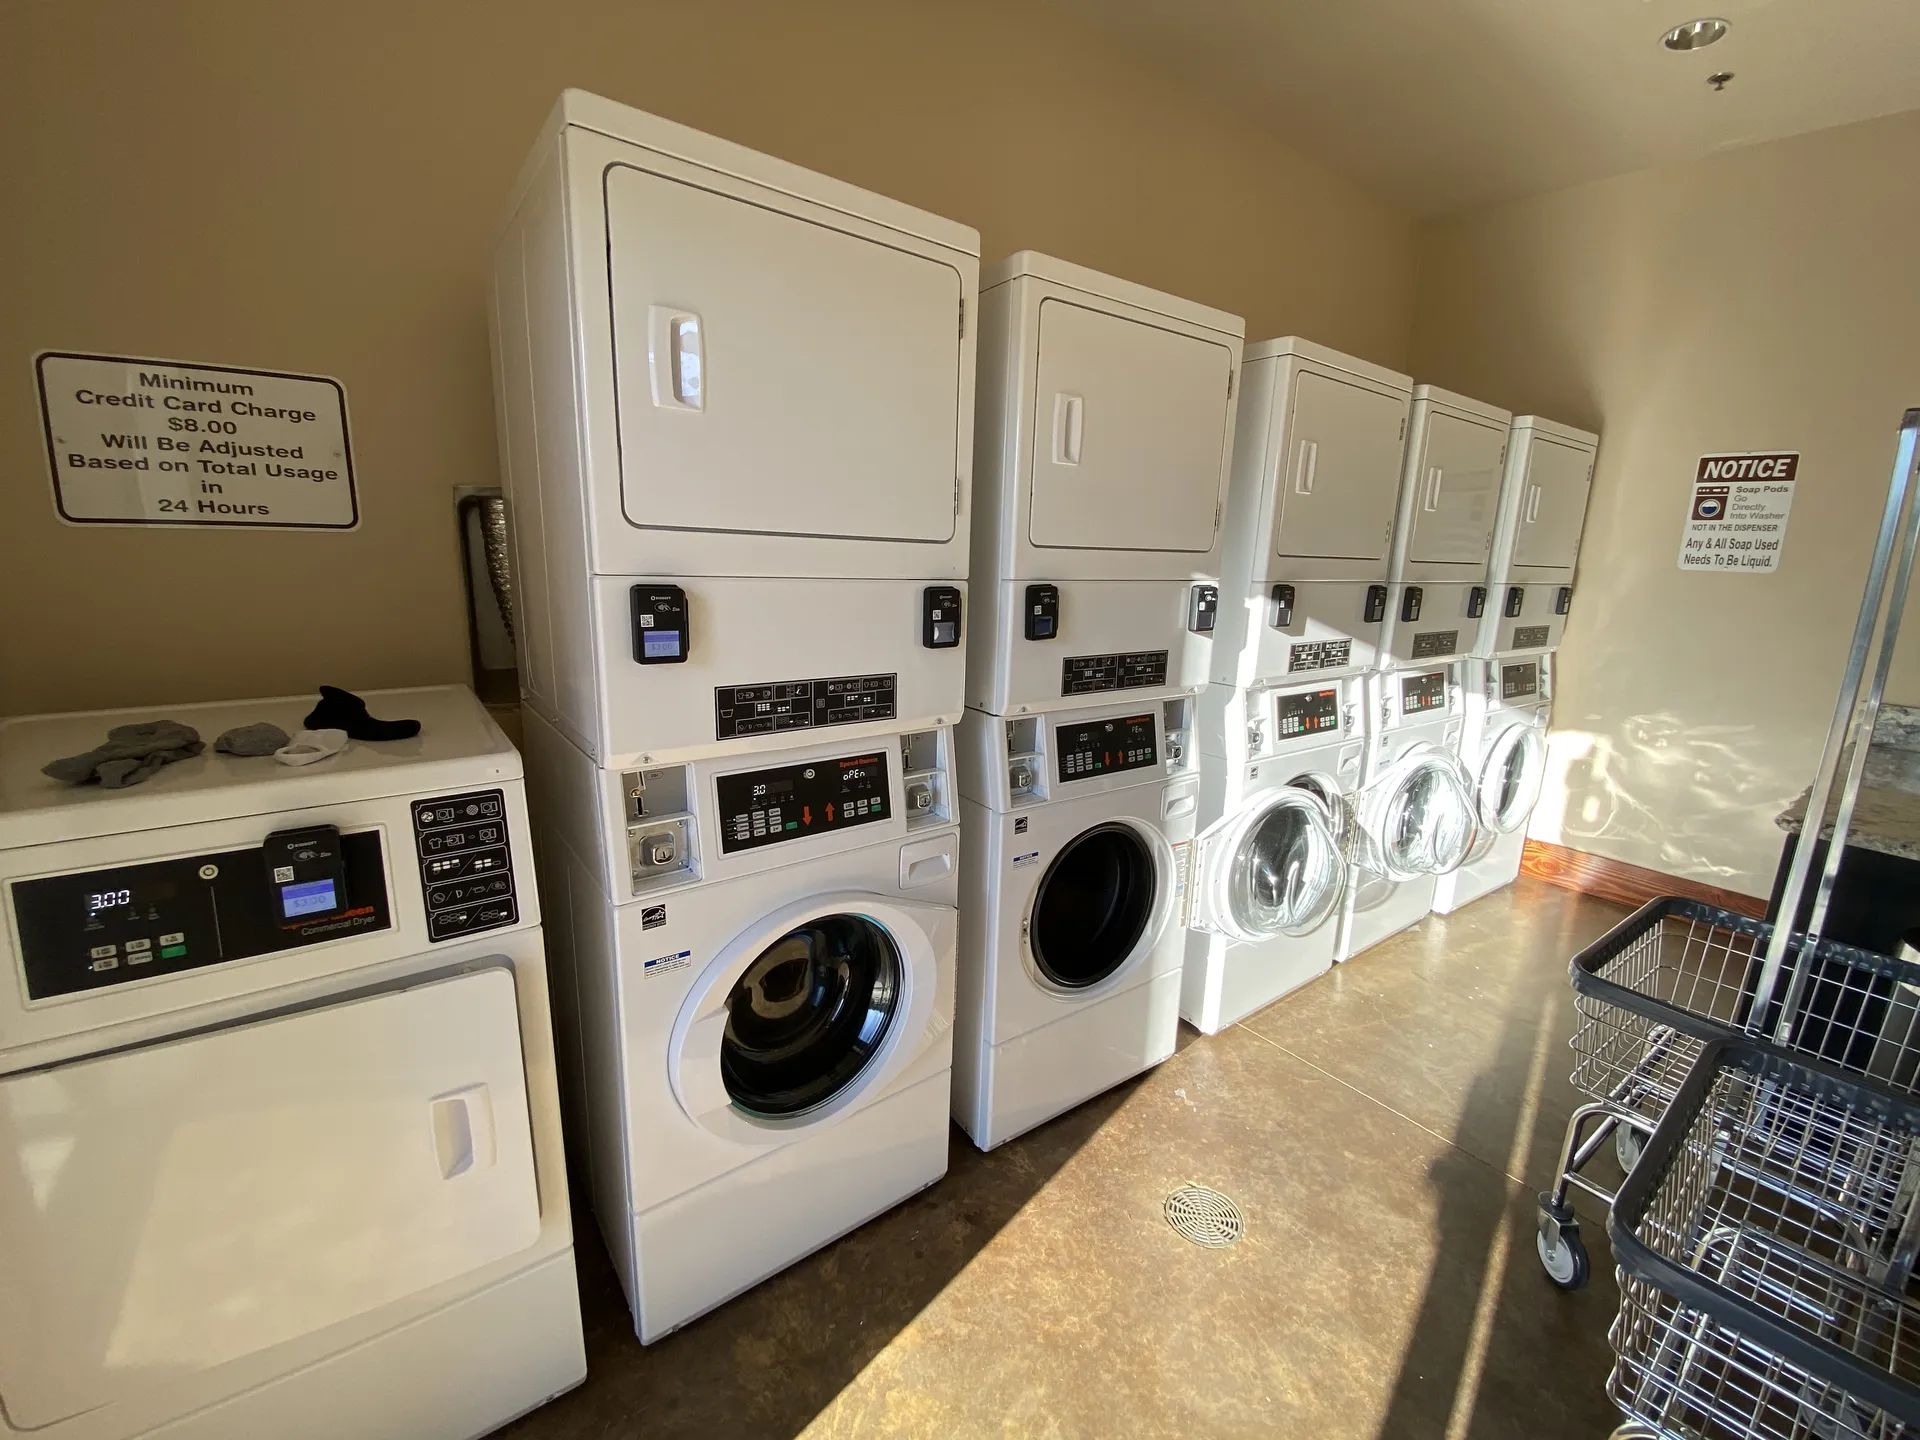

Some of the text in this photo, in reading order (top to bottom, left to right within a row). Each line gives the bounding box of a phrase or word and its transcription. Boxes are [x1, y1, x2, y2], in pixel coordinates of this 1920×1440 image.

[139, 372, 253, 396] Minimum
[75, 389, 316, 423] Credit Card Charge
[168, 417, 237, 434] $8.00
[100, 433, 304, 459] Will Be Adjusted
[68, 453, 338, 482] Based on Total Usage
[1703, 458, 1791, 479] NOTICE
[201, 480, 223, 493] in
[1736, 485, 1789, 494] Soap Pods
[1734, 494, 1747, 502] Go
[158, 498, 270, 515] 24 Hours
[1731, 503, 1766, 512] Directly
[1750, 512, 1785, 520] Washer
[1734, 524, 1778, 532] DISPENSER
[1685, 538, 1779, 551] Any & All Soap Used
[1683, 553, 1772, 569] Needs To Be Liquid.
[91, 889, 130, 910] 3.00
[302, 920, 351, 936] Commercial
[353, 915, 376, 926] Dryer
[656, 953, 680, 965] NOTICE
